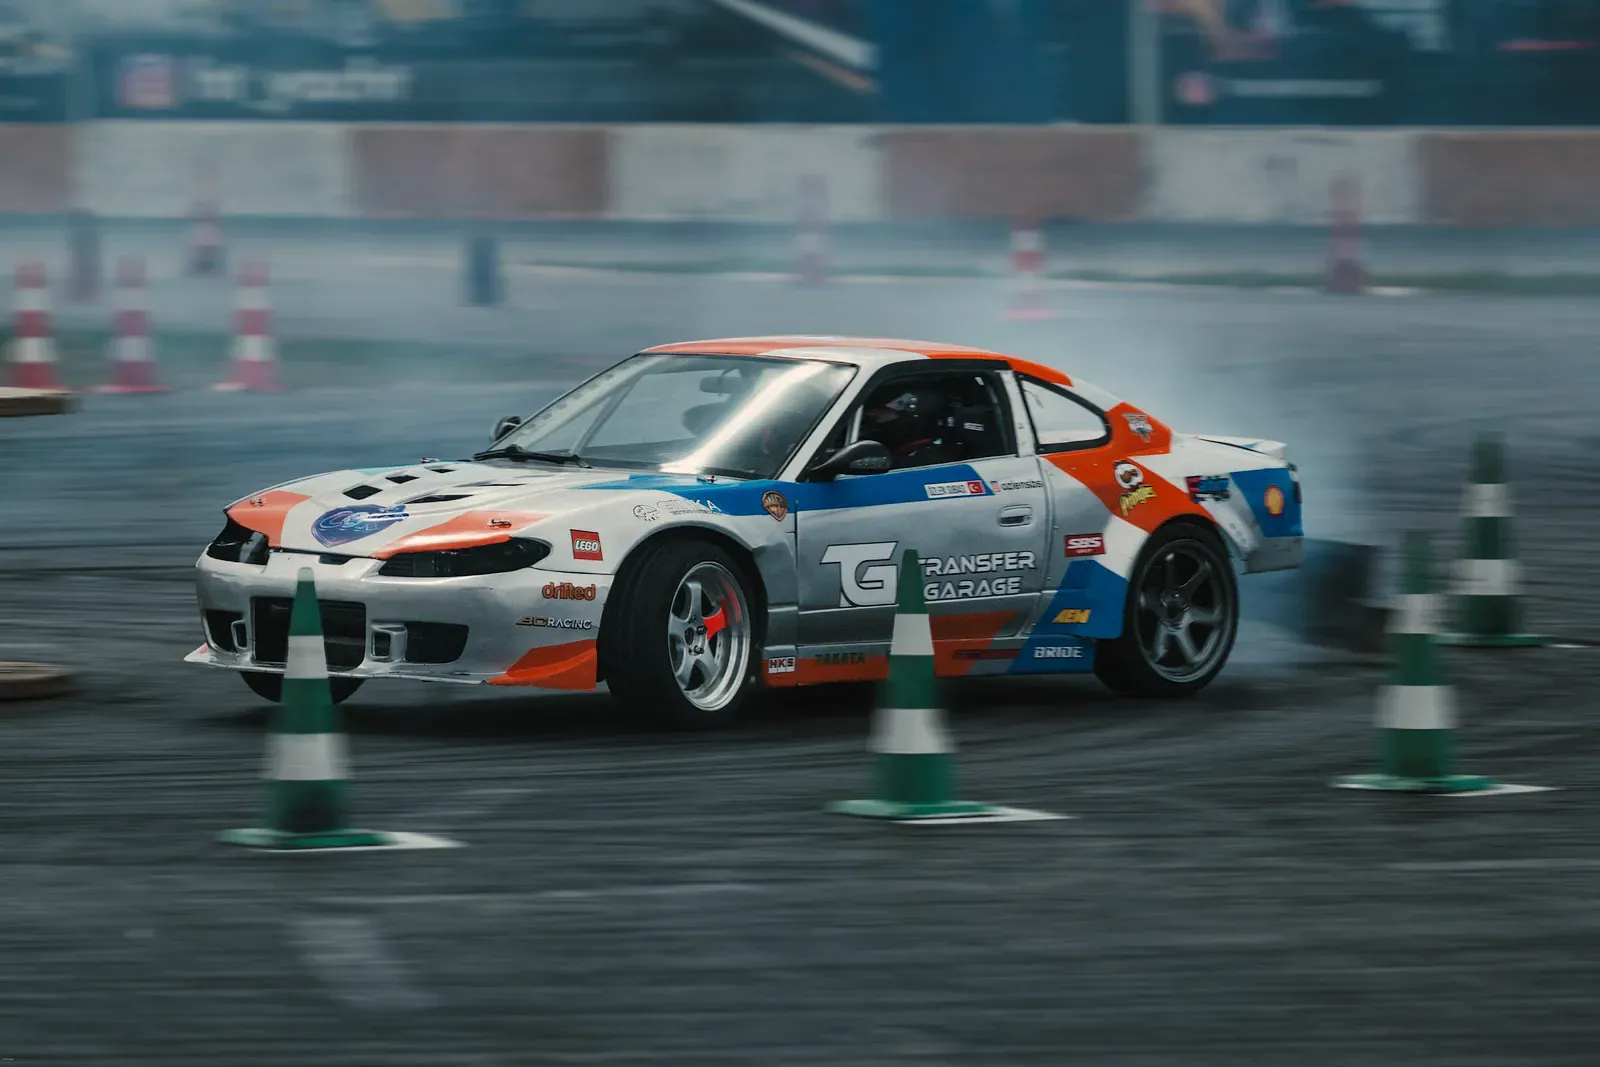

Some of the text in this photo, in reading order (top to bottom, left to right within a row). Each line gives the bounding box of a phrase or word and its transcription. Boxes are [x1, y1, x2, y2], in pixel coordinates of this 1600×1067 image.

[575, 540, 599, 552] LEGO
[542, 582, 596, 600] drifted
[924, 577, 1021, 600] GARAGE
[1034, 646, 1083, 658] BRIDE
[769, 658, 794, 669] HKS
